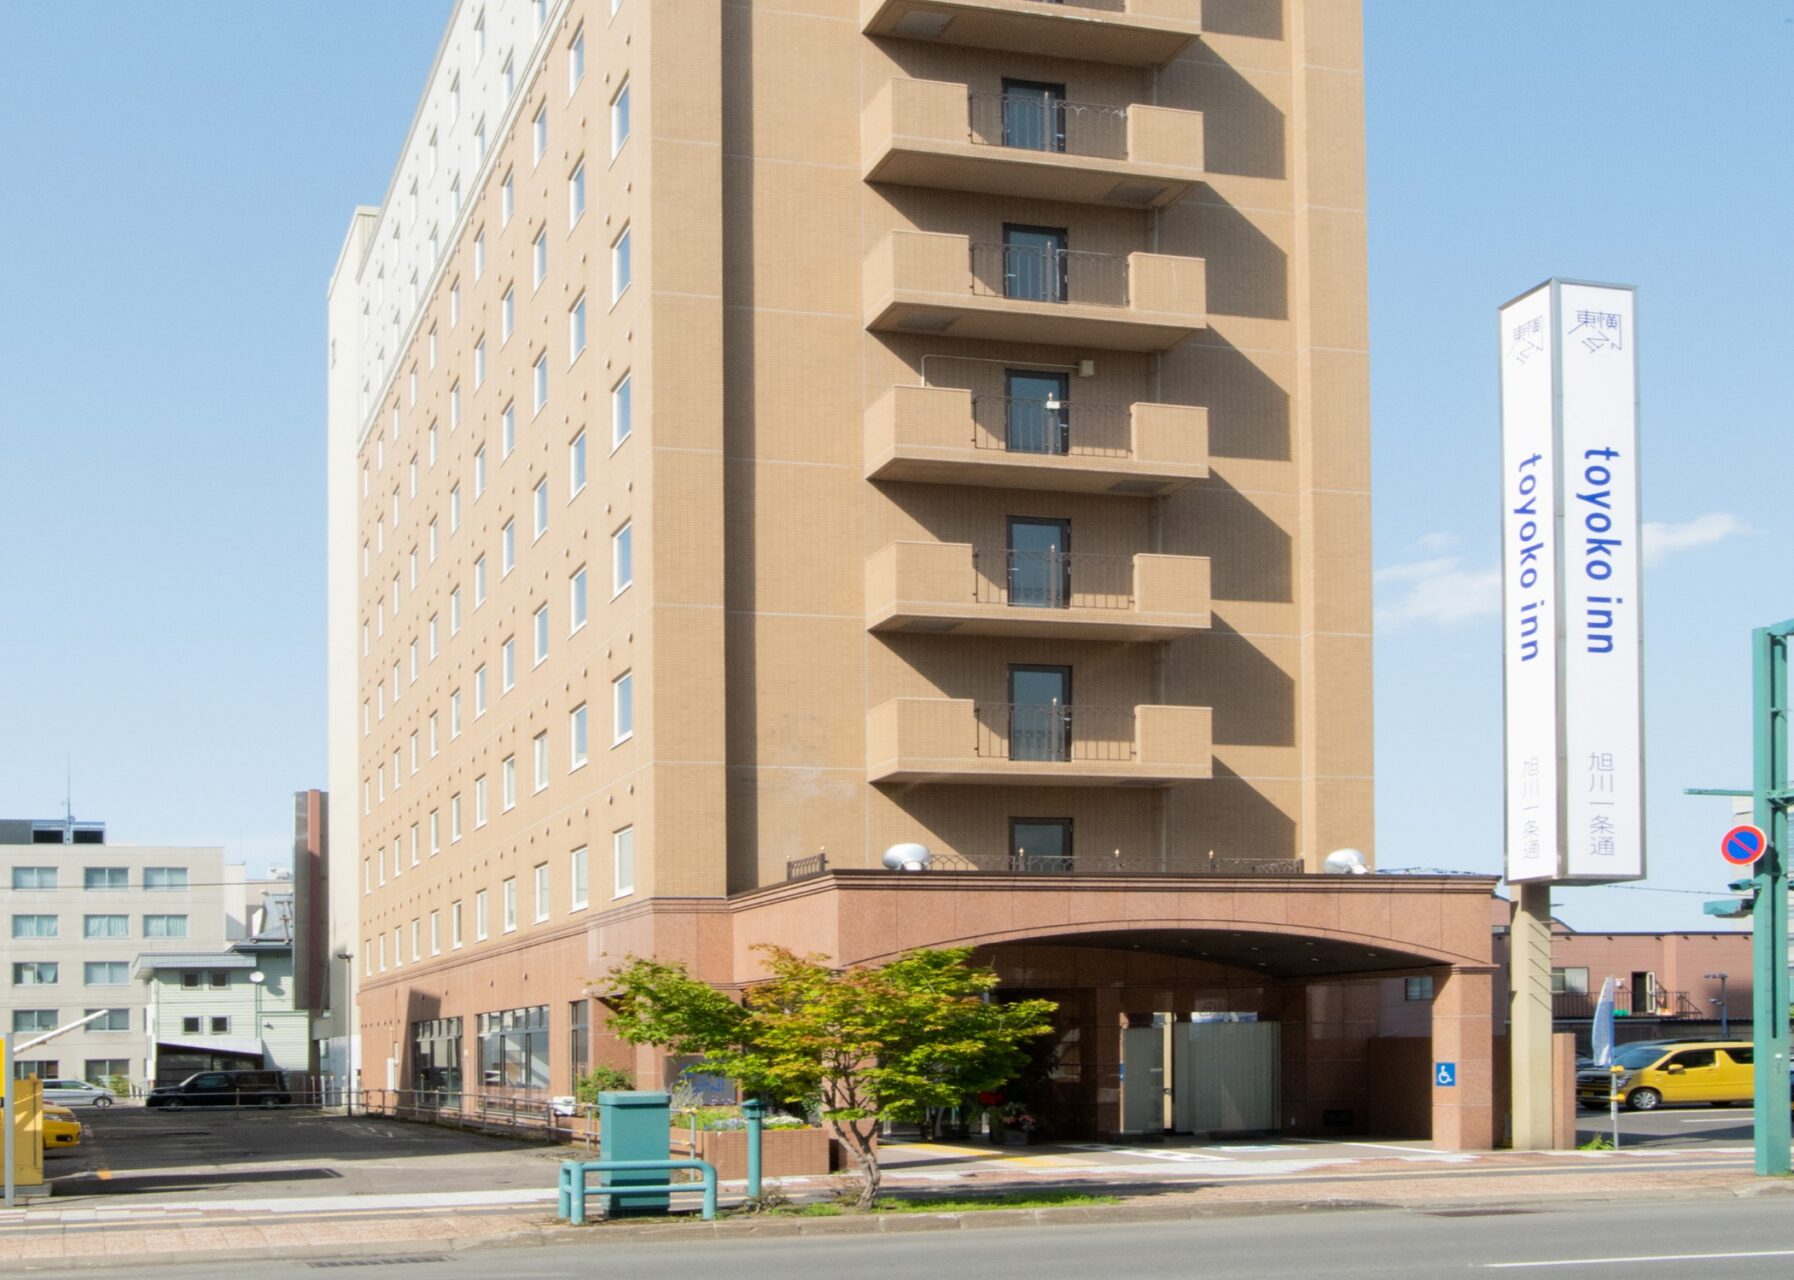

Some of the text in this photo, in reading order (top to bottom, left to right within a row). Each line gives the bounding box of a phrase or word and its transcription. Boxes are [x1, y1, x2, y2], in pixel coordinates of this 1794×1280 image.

[1513, 453, 1545, 662] toyoko inn
[1575, 446, 1624, 654] toyoko inn
[1522, 756, 1541, 860] 旭川一条通
[1588, 751, 1616, 857] 旭川一条通
